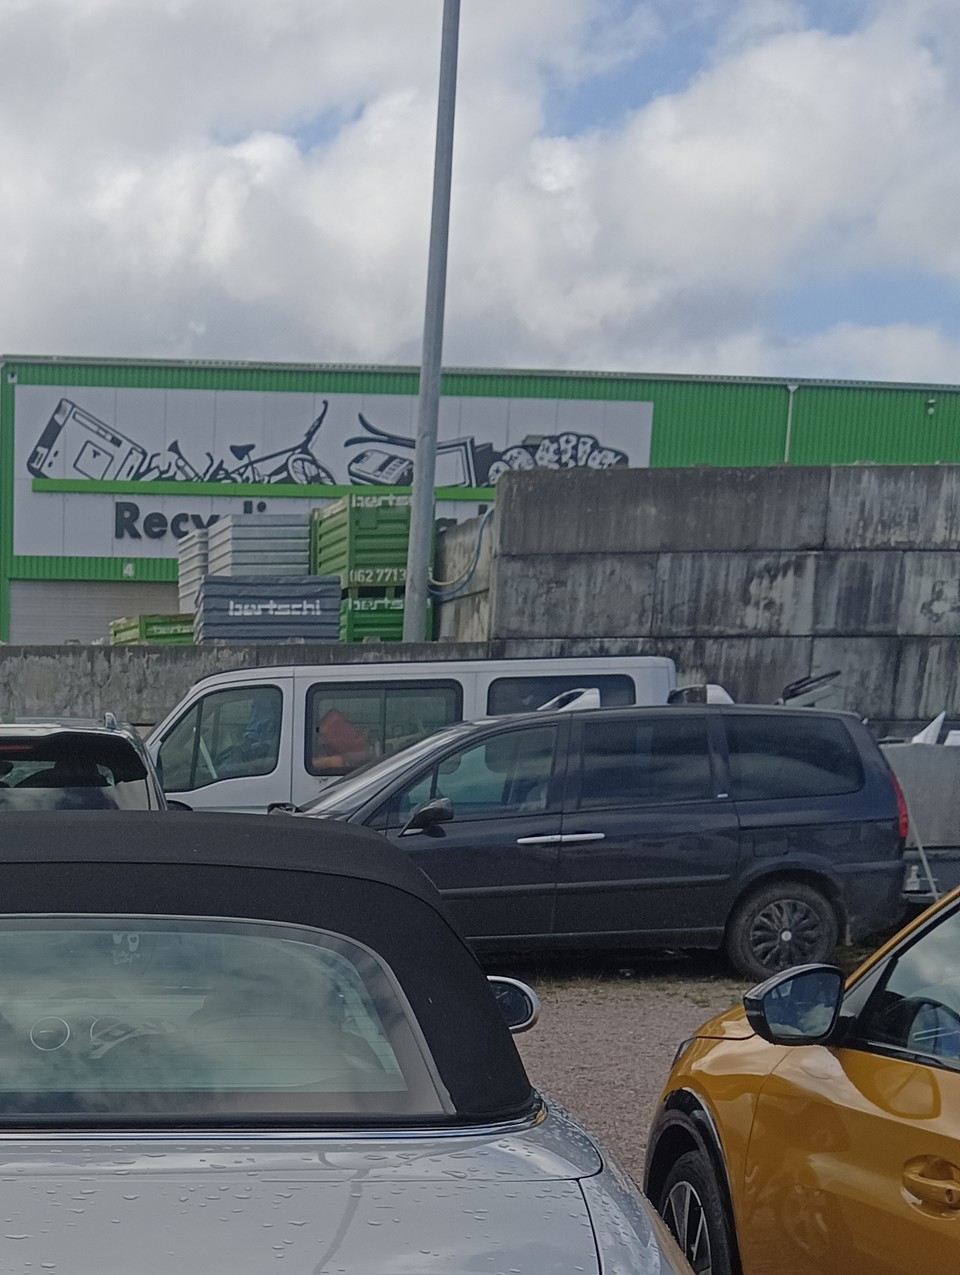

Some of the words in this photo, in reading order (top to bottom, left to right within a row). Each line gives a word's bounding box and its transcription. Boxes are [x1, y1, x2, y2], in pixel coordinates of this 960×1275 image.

[351, 493, 409, 508] berts
[122, 563, 135, 578] 4
[228, 600, 321, 616] bertschi
